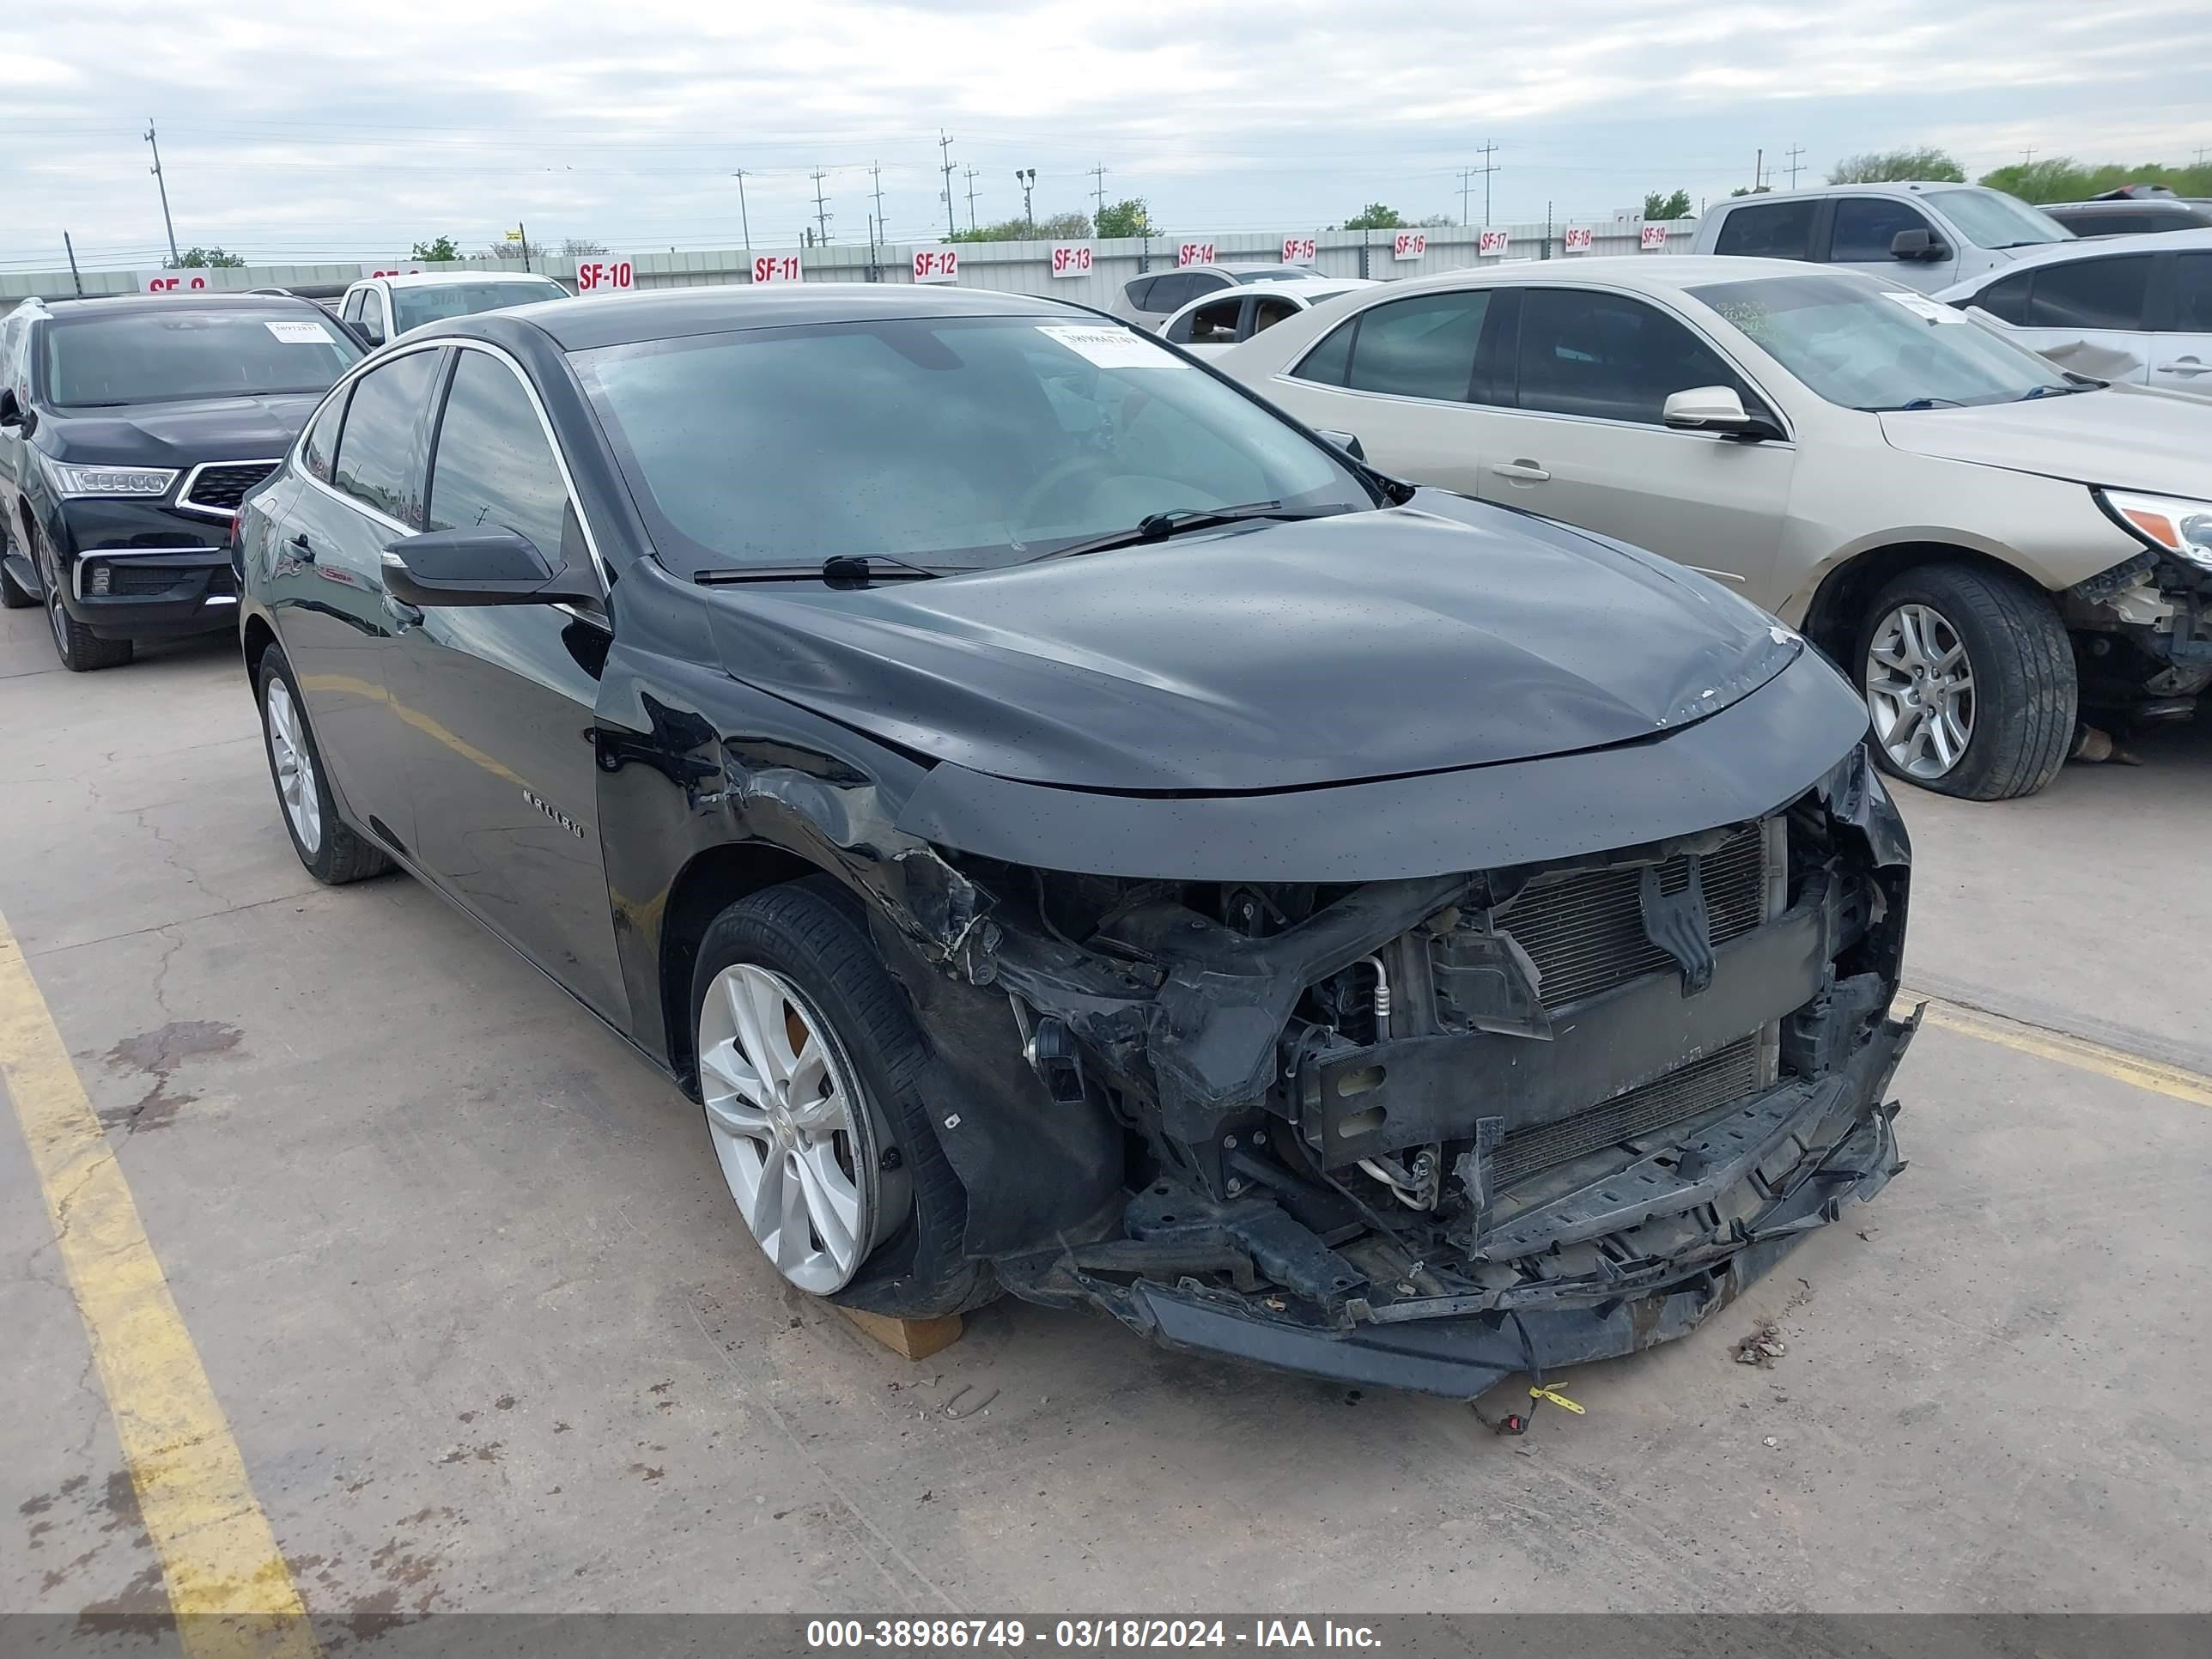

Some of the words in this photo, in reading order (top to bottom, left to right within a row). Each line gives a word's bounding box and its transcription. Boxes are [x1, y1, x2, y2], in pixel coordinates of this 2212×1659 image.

[1396, 235, 1425, 254] SF-16
[1481, 233, 1508, 250] SF-17
[1566, 229, 1591, 246] SF-18
[1643, 227, 1665, 243] SF-19
[1054, 248, 1091, 270] SF-13
[1180, 244, 1213, 265] SF-14
[1284, 240, 1315, 260] SF-15
[755, 257, 799, 283] SF-11
[915, 252, 957, 276] SF-12
[578, 262, 632, 290] SF-10
